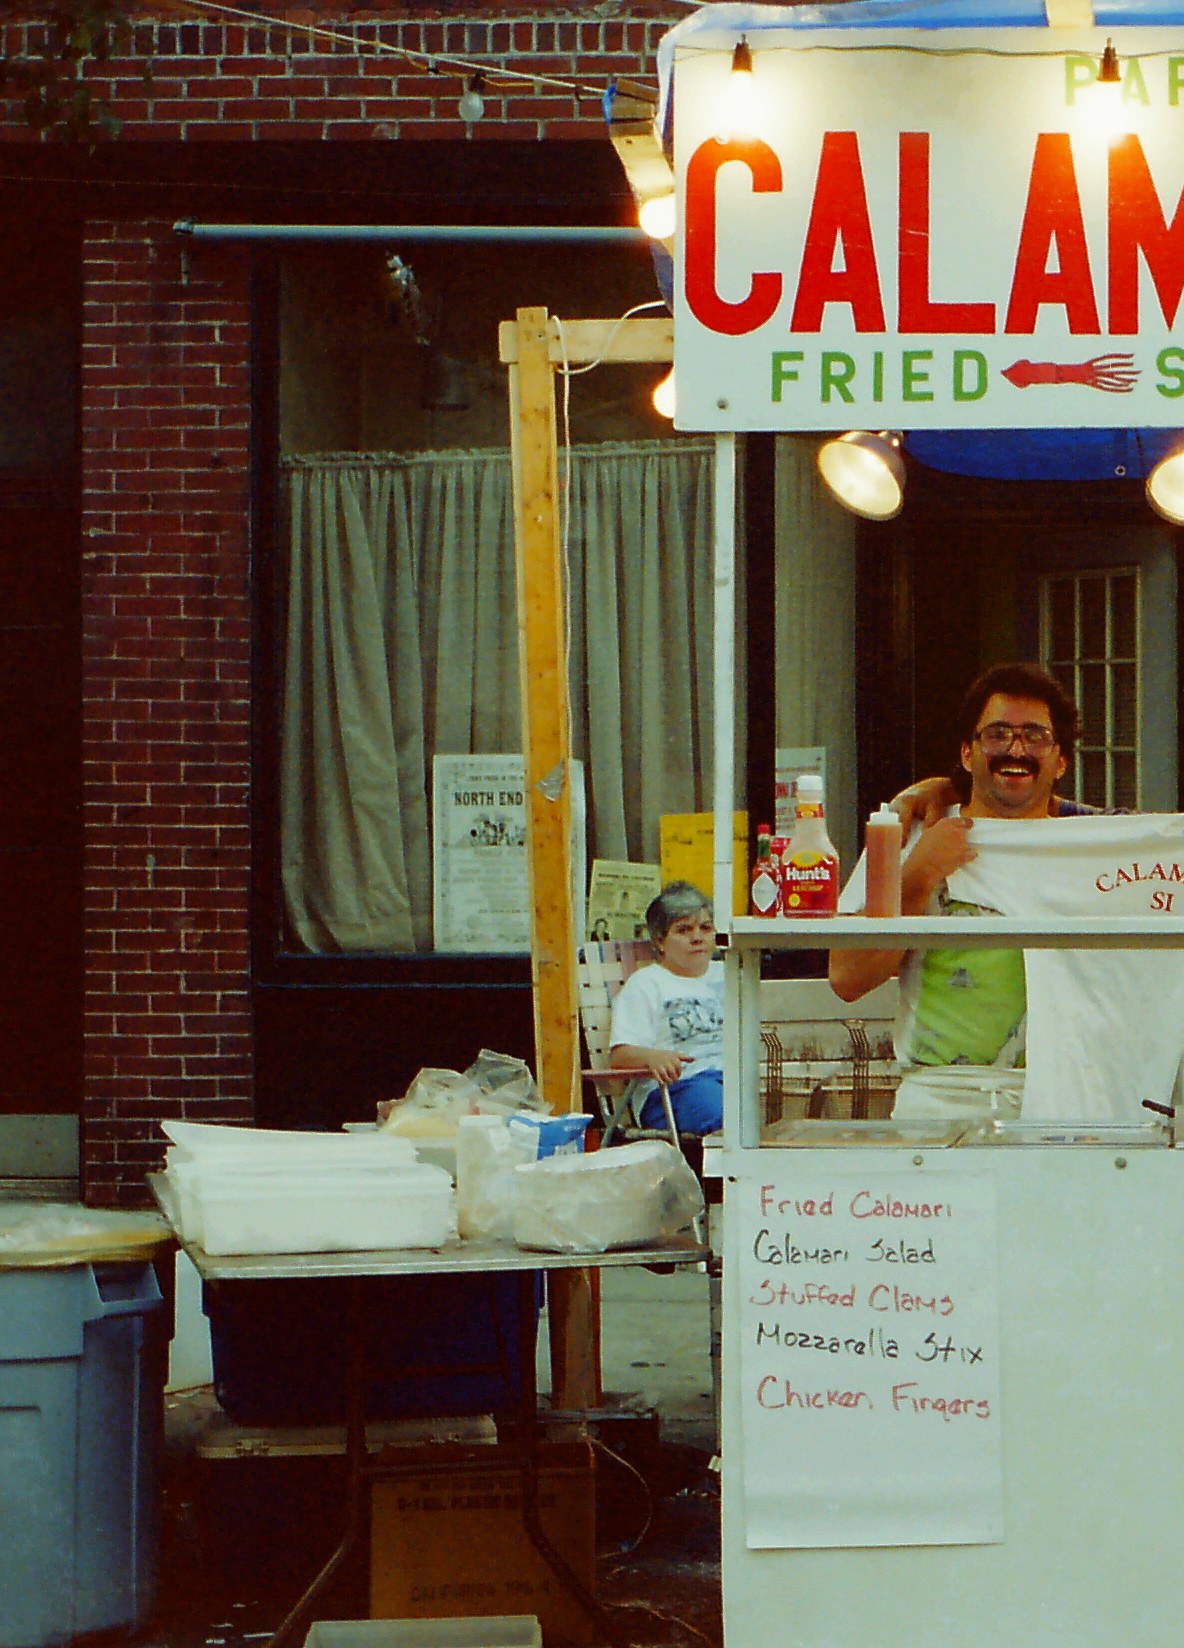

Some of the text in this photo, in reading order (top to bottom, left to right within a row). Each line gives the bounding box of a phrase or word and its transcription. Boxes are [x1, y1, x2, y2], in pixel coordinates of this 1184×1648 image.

[771, 350, 989, 403] FRIED
[454, 791, 523, 806] NORTH END
[786, 866, 831, 881] Hunt's
[1150, 890, 1174, 912] SI
[760, 1184, 952, 1219] Fried Calamari
[753, 1229, 936, 1265] Calamari Salad
[749, 1279, 856, 1308] Stuffed
[756, 1321, 983, 1365] Mozzarella Stix
[756, 1375, 991, 1422] Chicken Fingers
